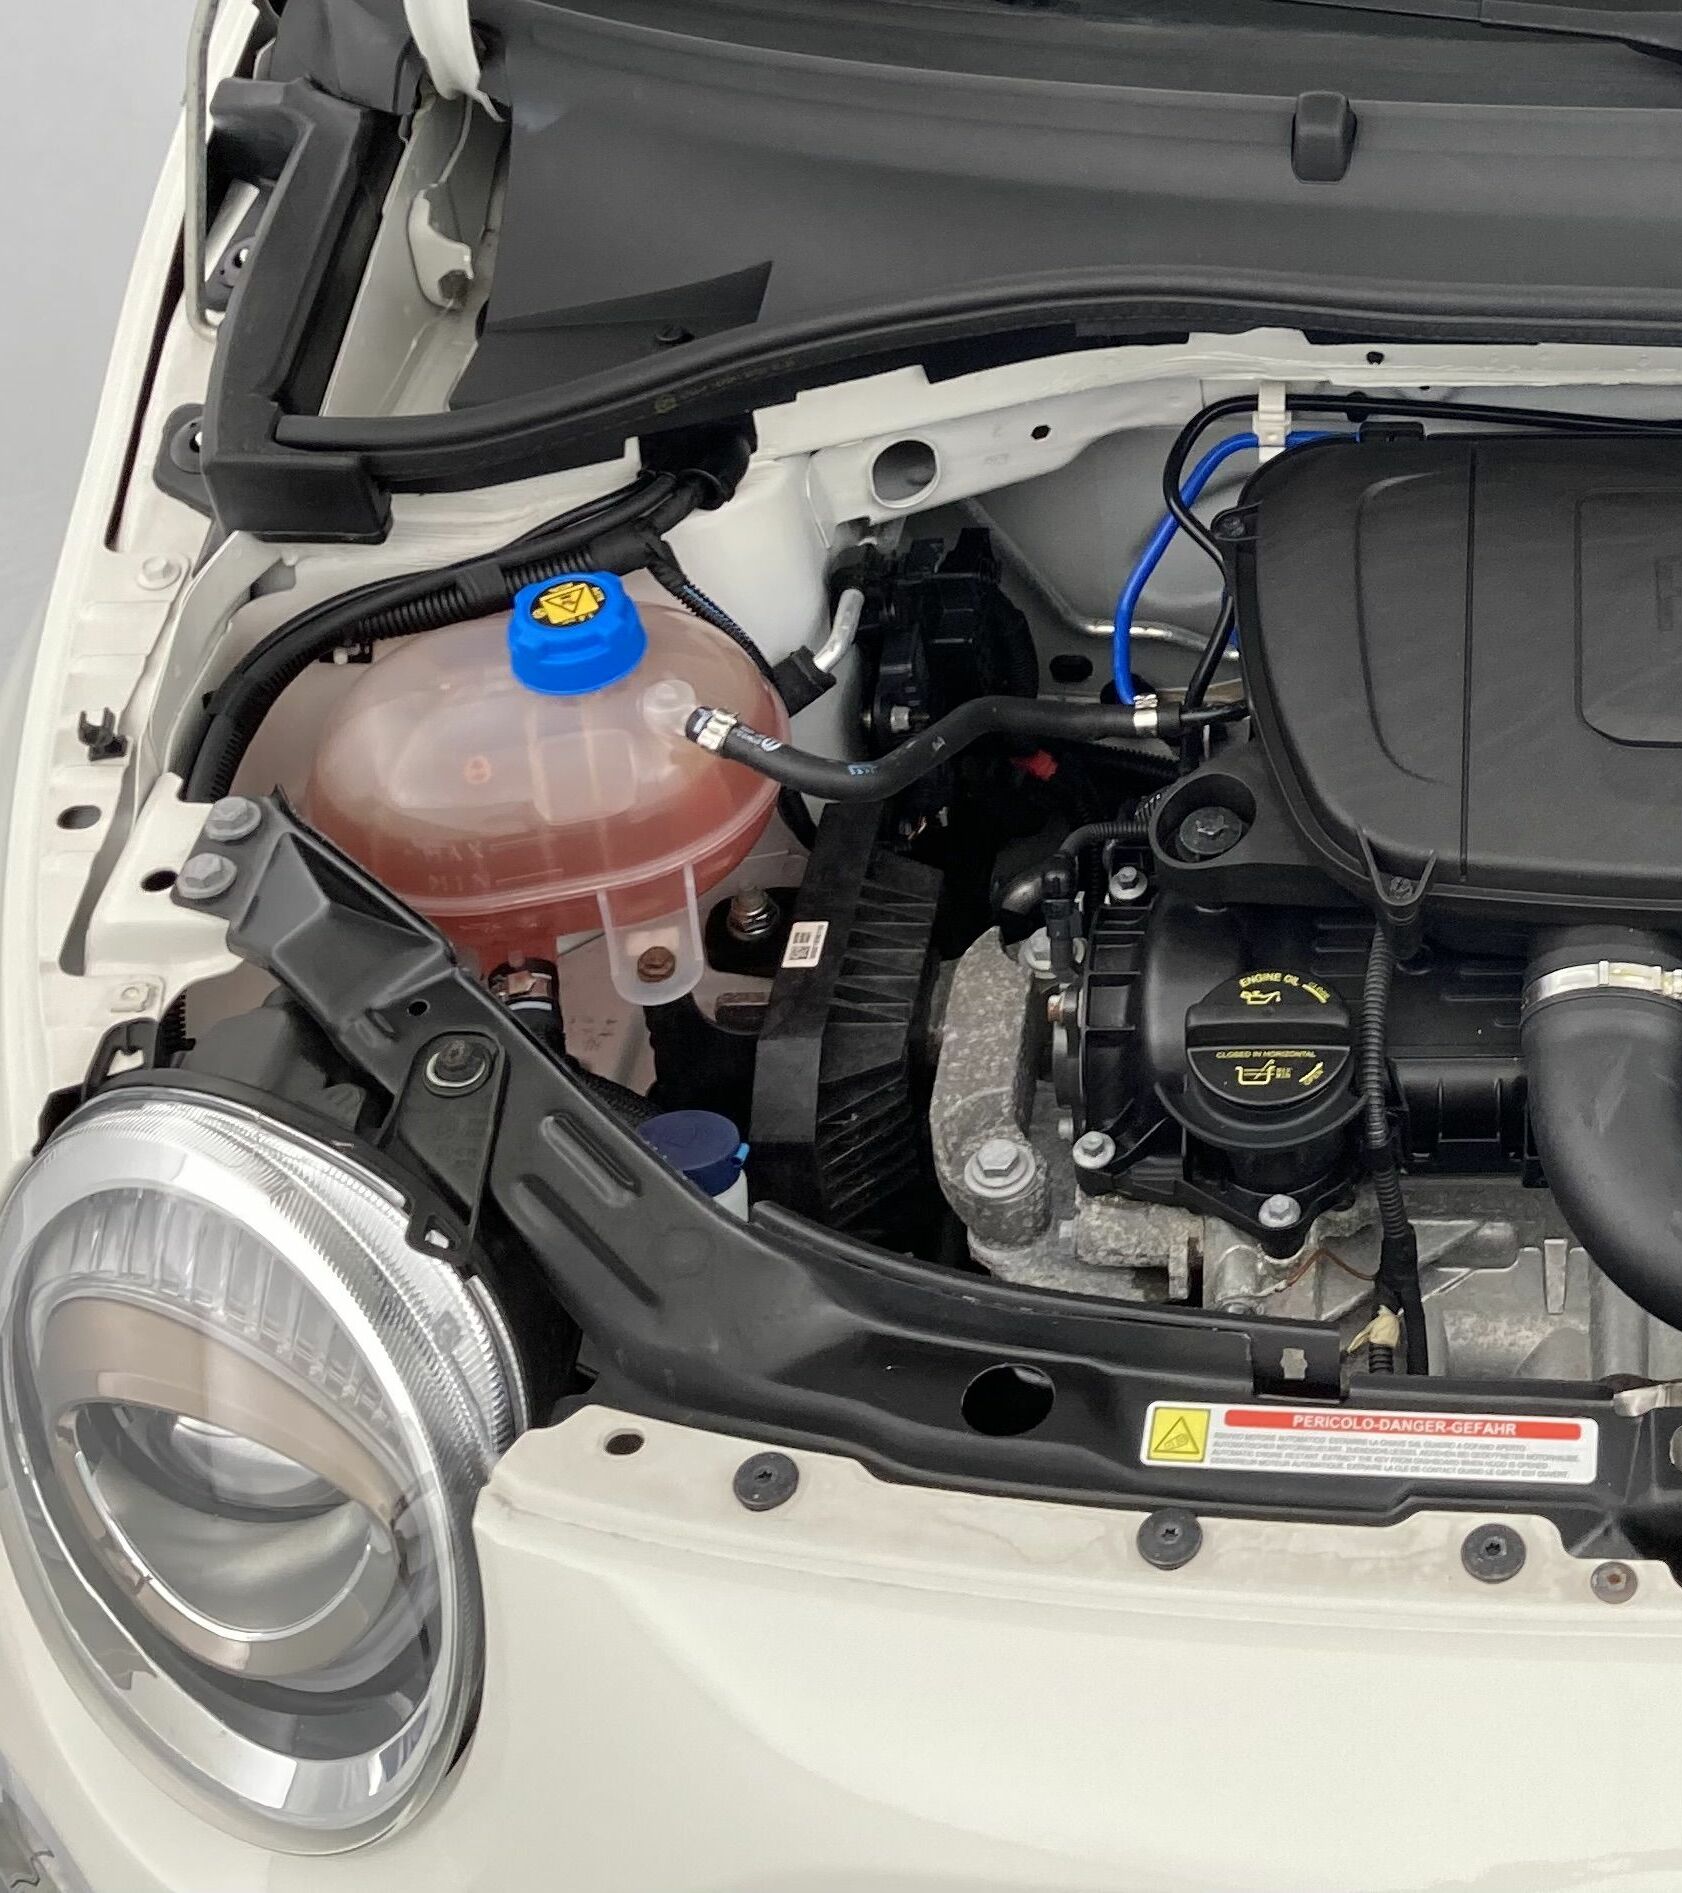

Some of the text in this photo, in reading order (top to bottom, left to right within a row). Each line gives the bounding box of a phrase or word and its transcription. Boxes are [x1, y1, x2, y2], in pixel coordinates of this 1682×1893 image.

[1239, 972, 1300, 988] ENGINE OIL
[1292, 1415, 1517, 1436] PERICOLO-DANGER-GEFAHR
